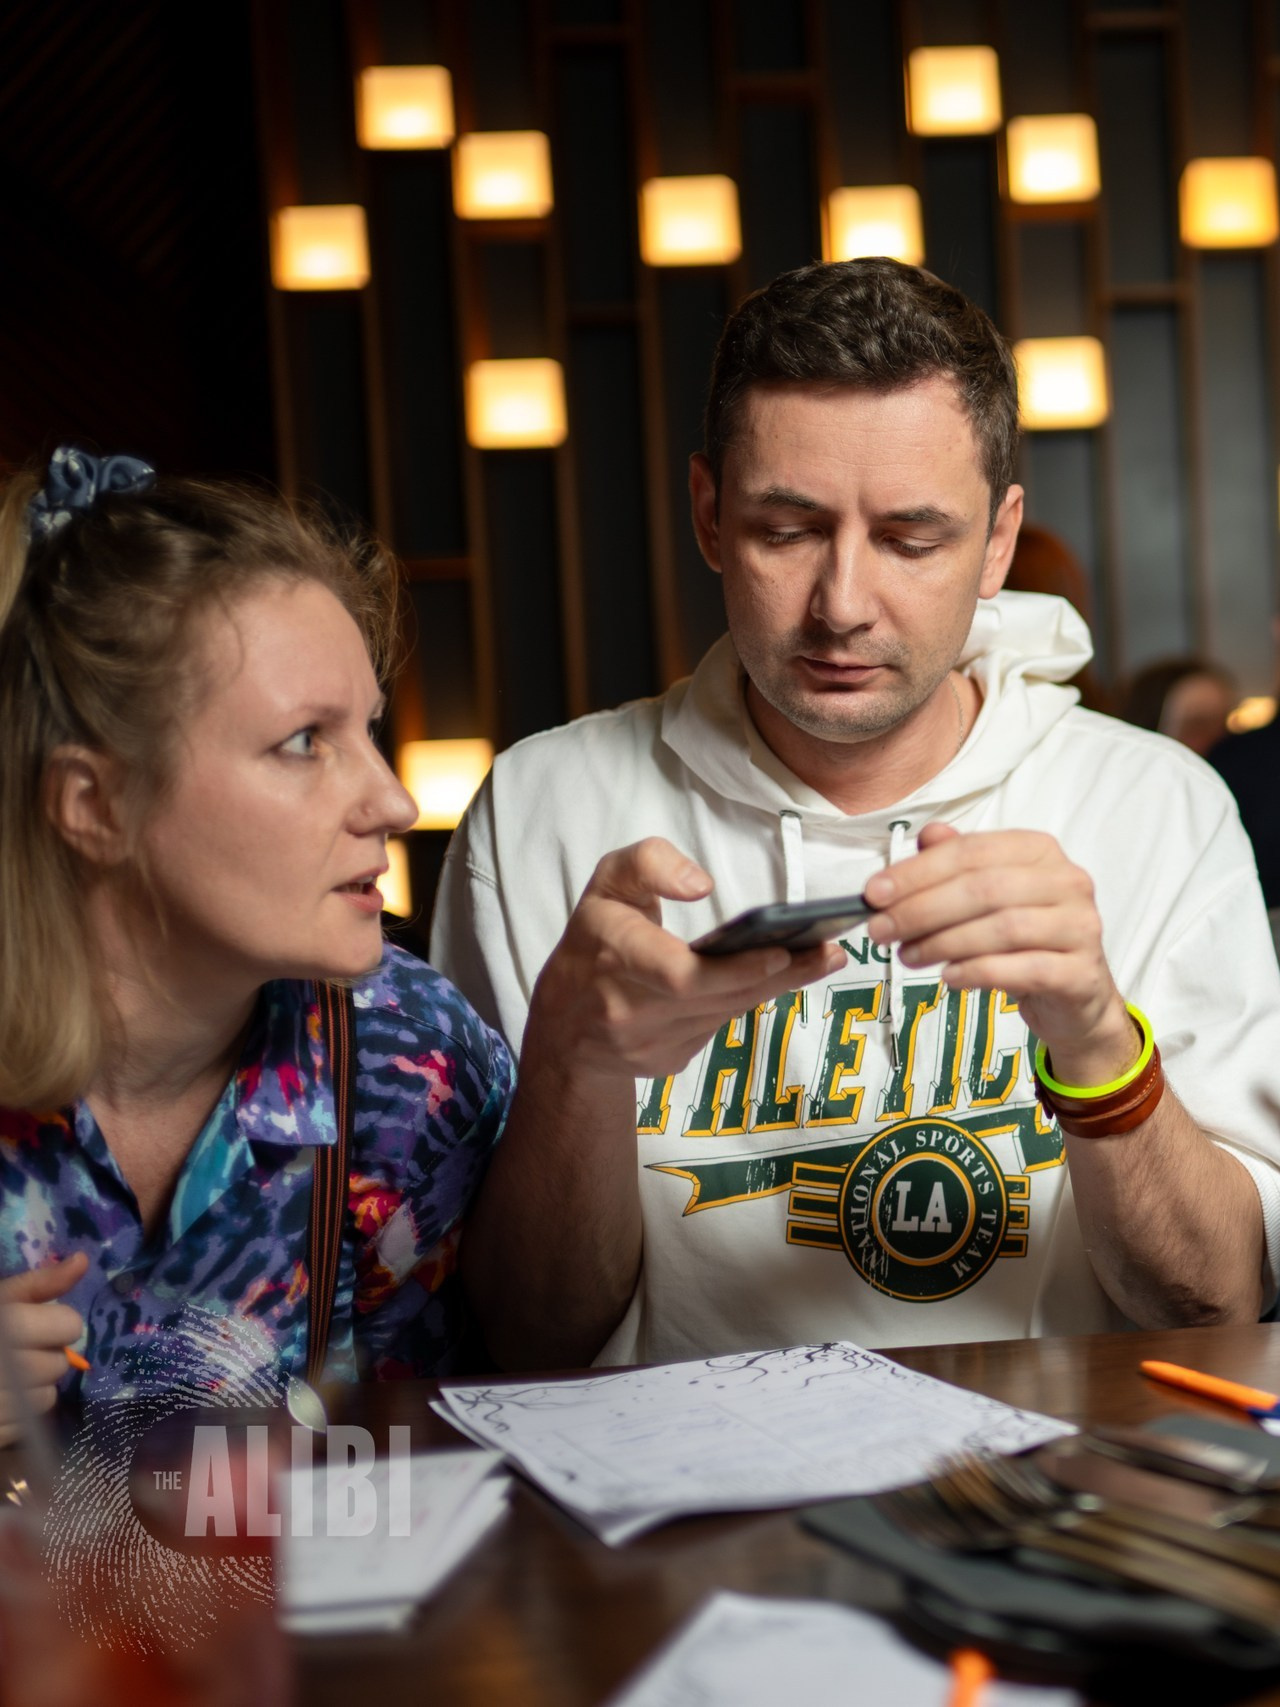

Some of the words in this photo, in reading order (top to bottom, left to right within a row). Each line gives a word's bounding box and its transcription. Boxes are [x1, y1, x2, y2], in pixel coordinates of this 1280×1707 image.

[915, 1130, 995, 1196] SPORTS
[850, 1139, 906, 1282] NATIONAL
[891, 1181, 952, 1233] LA
[951, 1208, 998, 1278] TEAM
